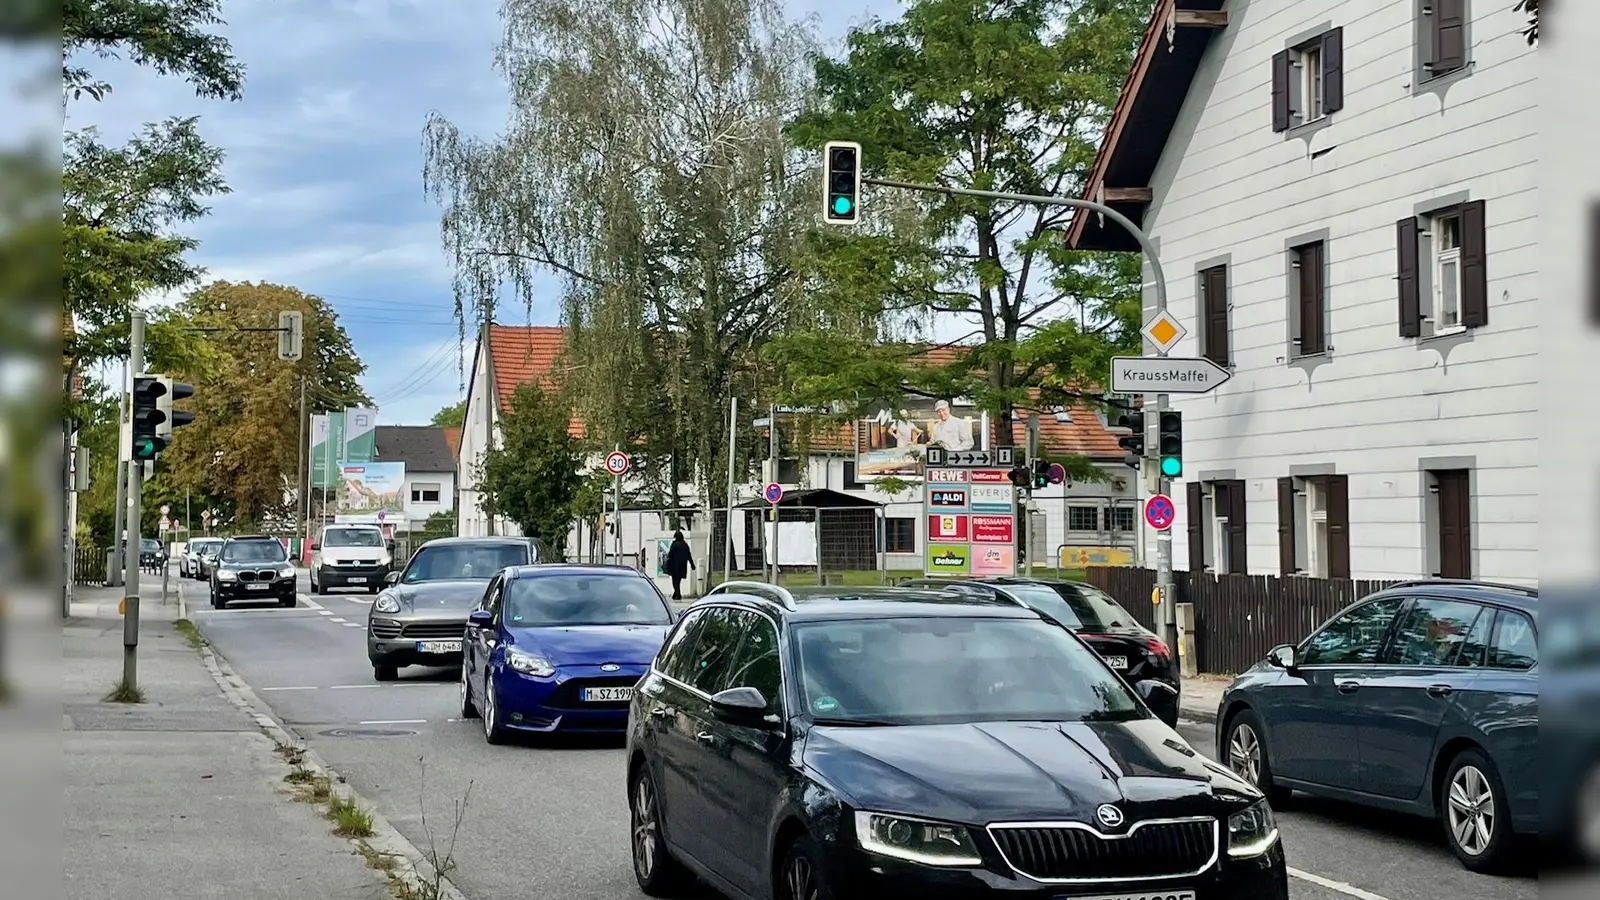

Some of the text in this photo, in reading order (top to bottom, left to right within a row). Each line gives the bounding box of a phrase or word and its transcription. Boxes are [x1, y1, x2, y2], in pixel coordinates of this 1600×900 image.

[1123, 369, 1208, 382] KraussMaffei
[611, 458, 623, 468] 30
[932, 471, 963, 482] REWE
[942, 493, 963, 501] ALDI
[973, 517, 1011, 526] ROSSMANN
[986, 549, 1000, 557] dm
[1110, 656, 1126, 667] 257
[586, 689, 593, 700] M
[599, 688, 612, 700] SZ
